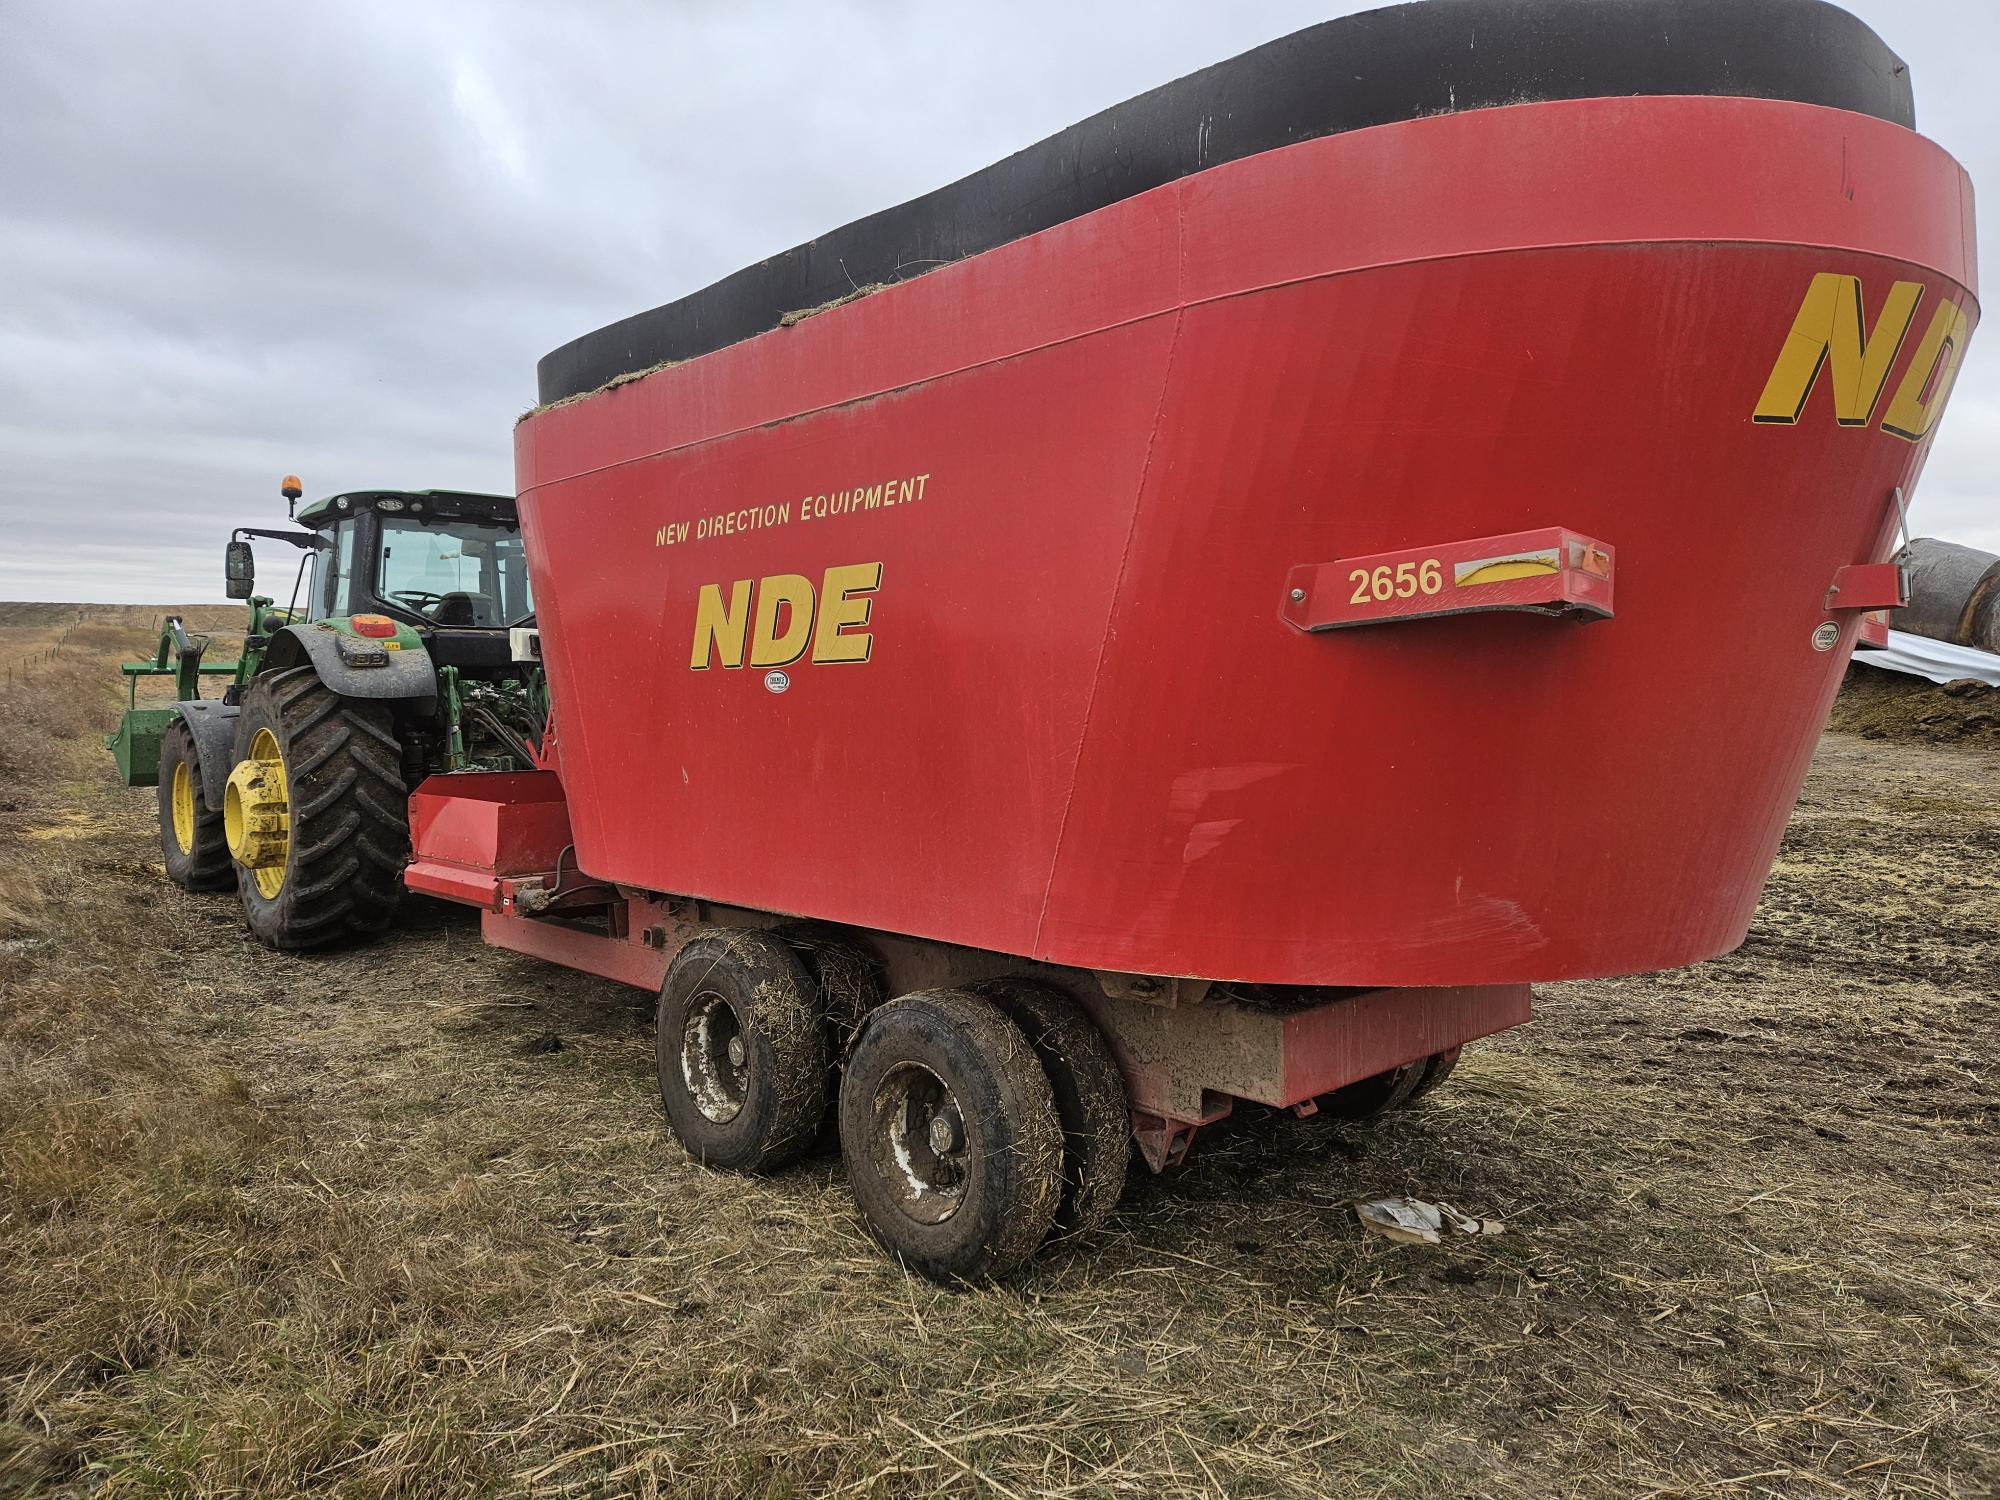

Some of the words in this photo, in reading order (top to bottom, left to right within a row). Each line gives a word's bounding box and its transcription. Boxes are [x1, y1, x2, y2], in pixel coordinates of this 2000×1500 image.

[656, 521, 690, 546] NEW
[697, 501, 790, 539] DIRECTION
[801, 474, 930, 521] EQUIPMENT
[690, 561, 883, 671] NDE
[1348, 558, 1442, 605] 2656
